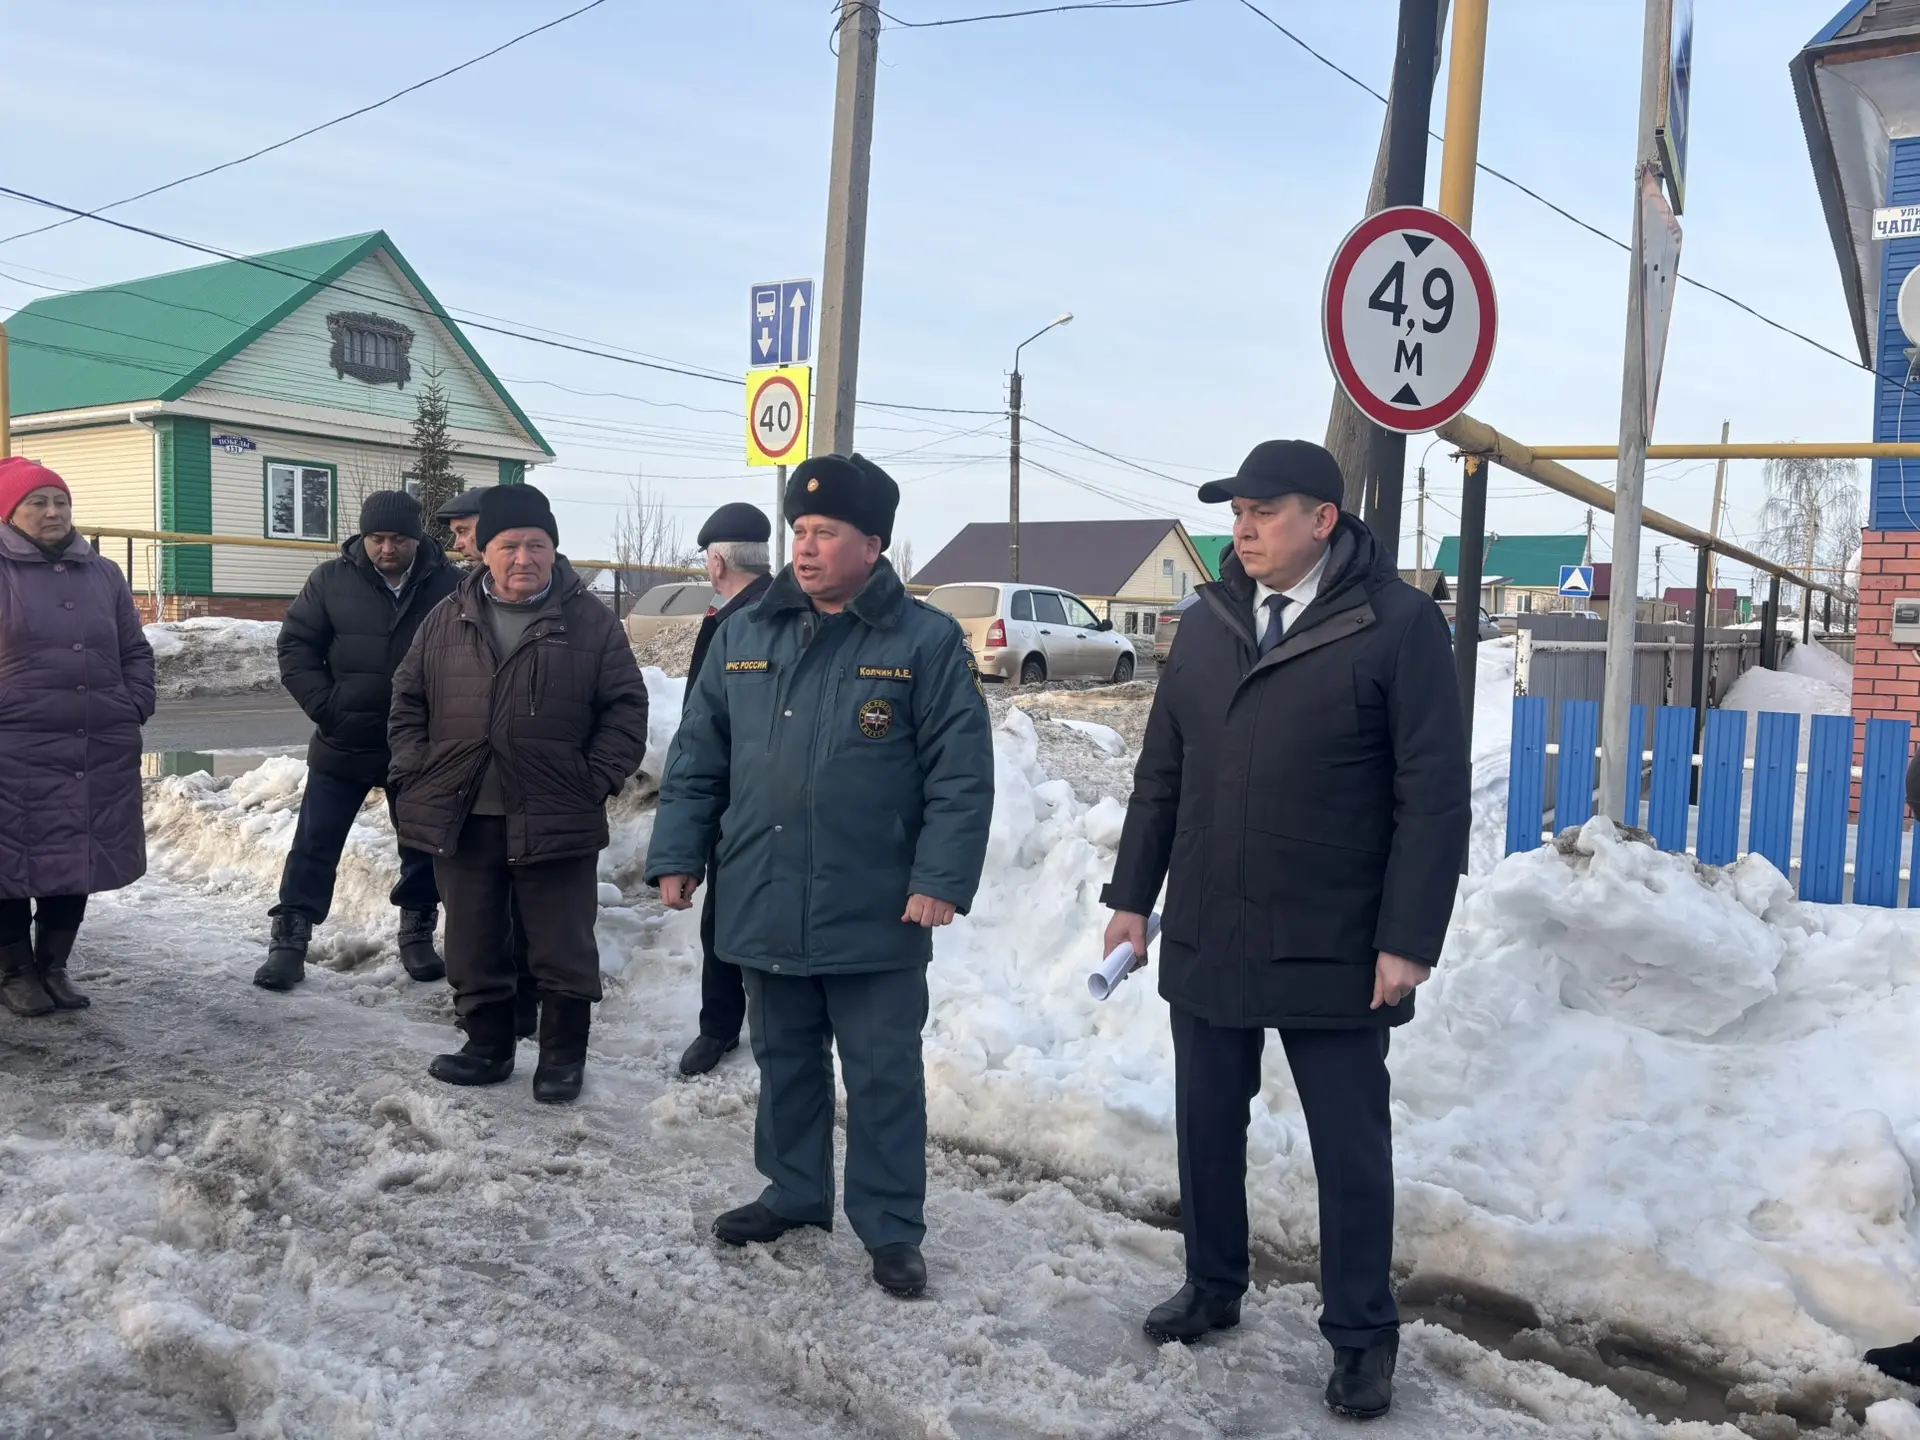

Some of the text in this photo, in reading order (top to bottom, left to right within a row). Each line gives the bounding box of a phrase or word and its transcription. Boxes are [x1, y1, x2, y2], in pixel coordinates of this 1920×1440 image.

[1368, 260, 1454, 336] 4,9
[760, 401, 791, 432] 40
[740, 660, 768, 670] РОССИИ
[859, 667, 912, 678] Колчин А.Е.
